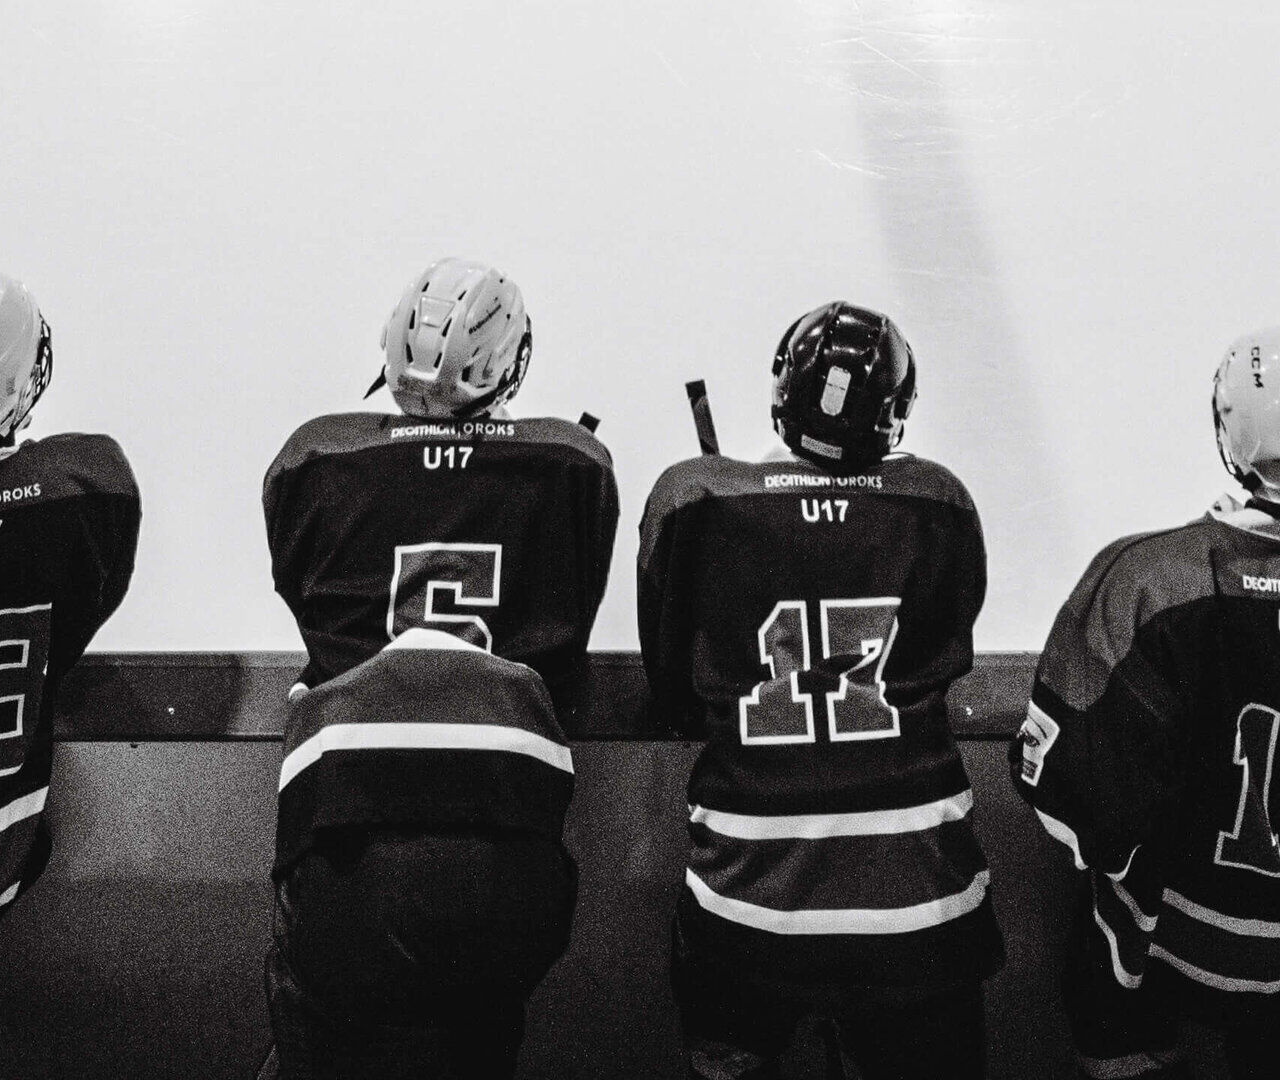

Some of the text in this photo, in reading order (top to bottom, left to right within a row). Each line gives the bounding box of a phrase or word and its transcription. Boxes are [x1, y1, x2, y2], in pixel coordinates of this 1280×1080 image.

[1251, 346, 1264, 388] CCM
[463, 422, 515, 436] OROKS
[423, 446, 474, 469] U17
[801, 498, 849, 522] U17
[738, 595, 902, 747] 17
